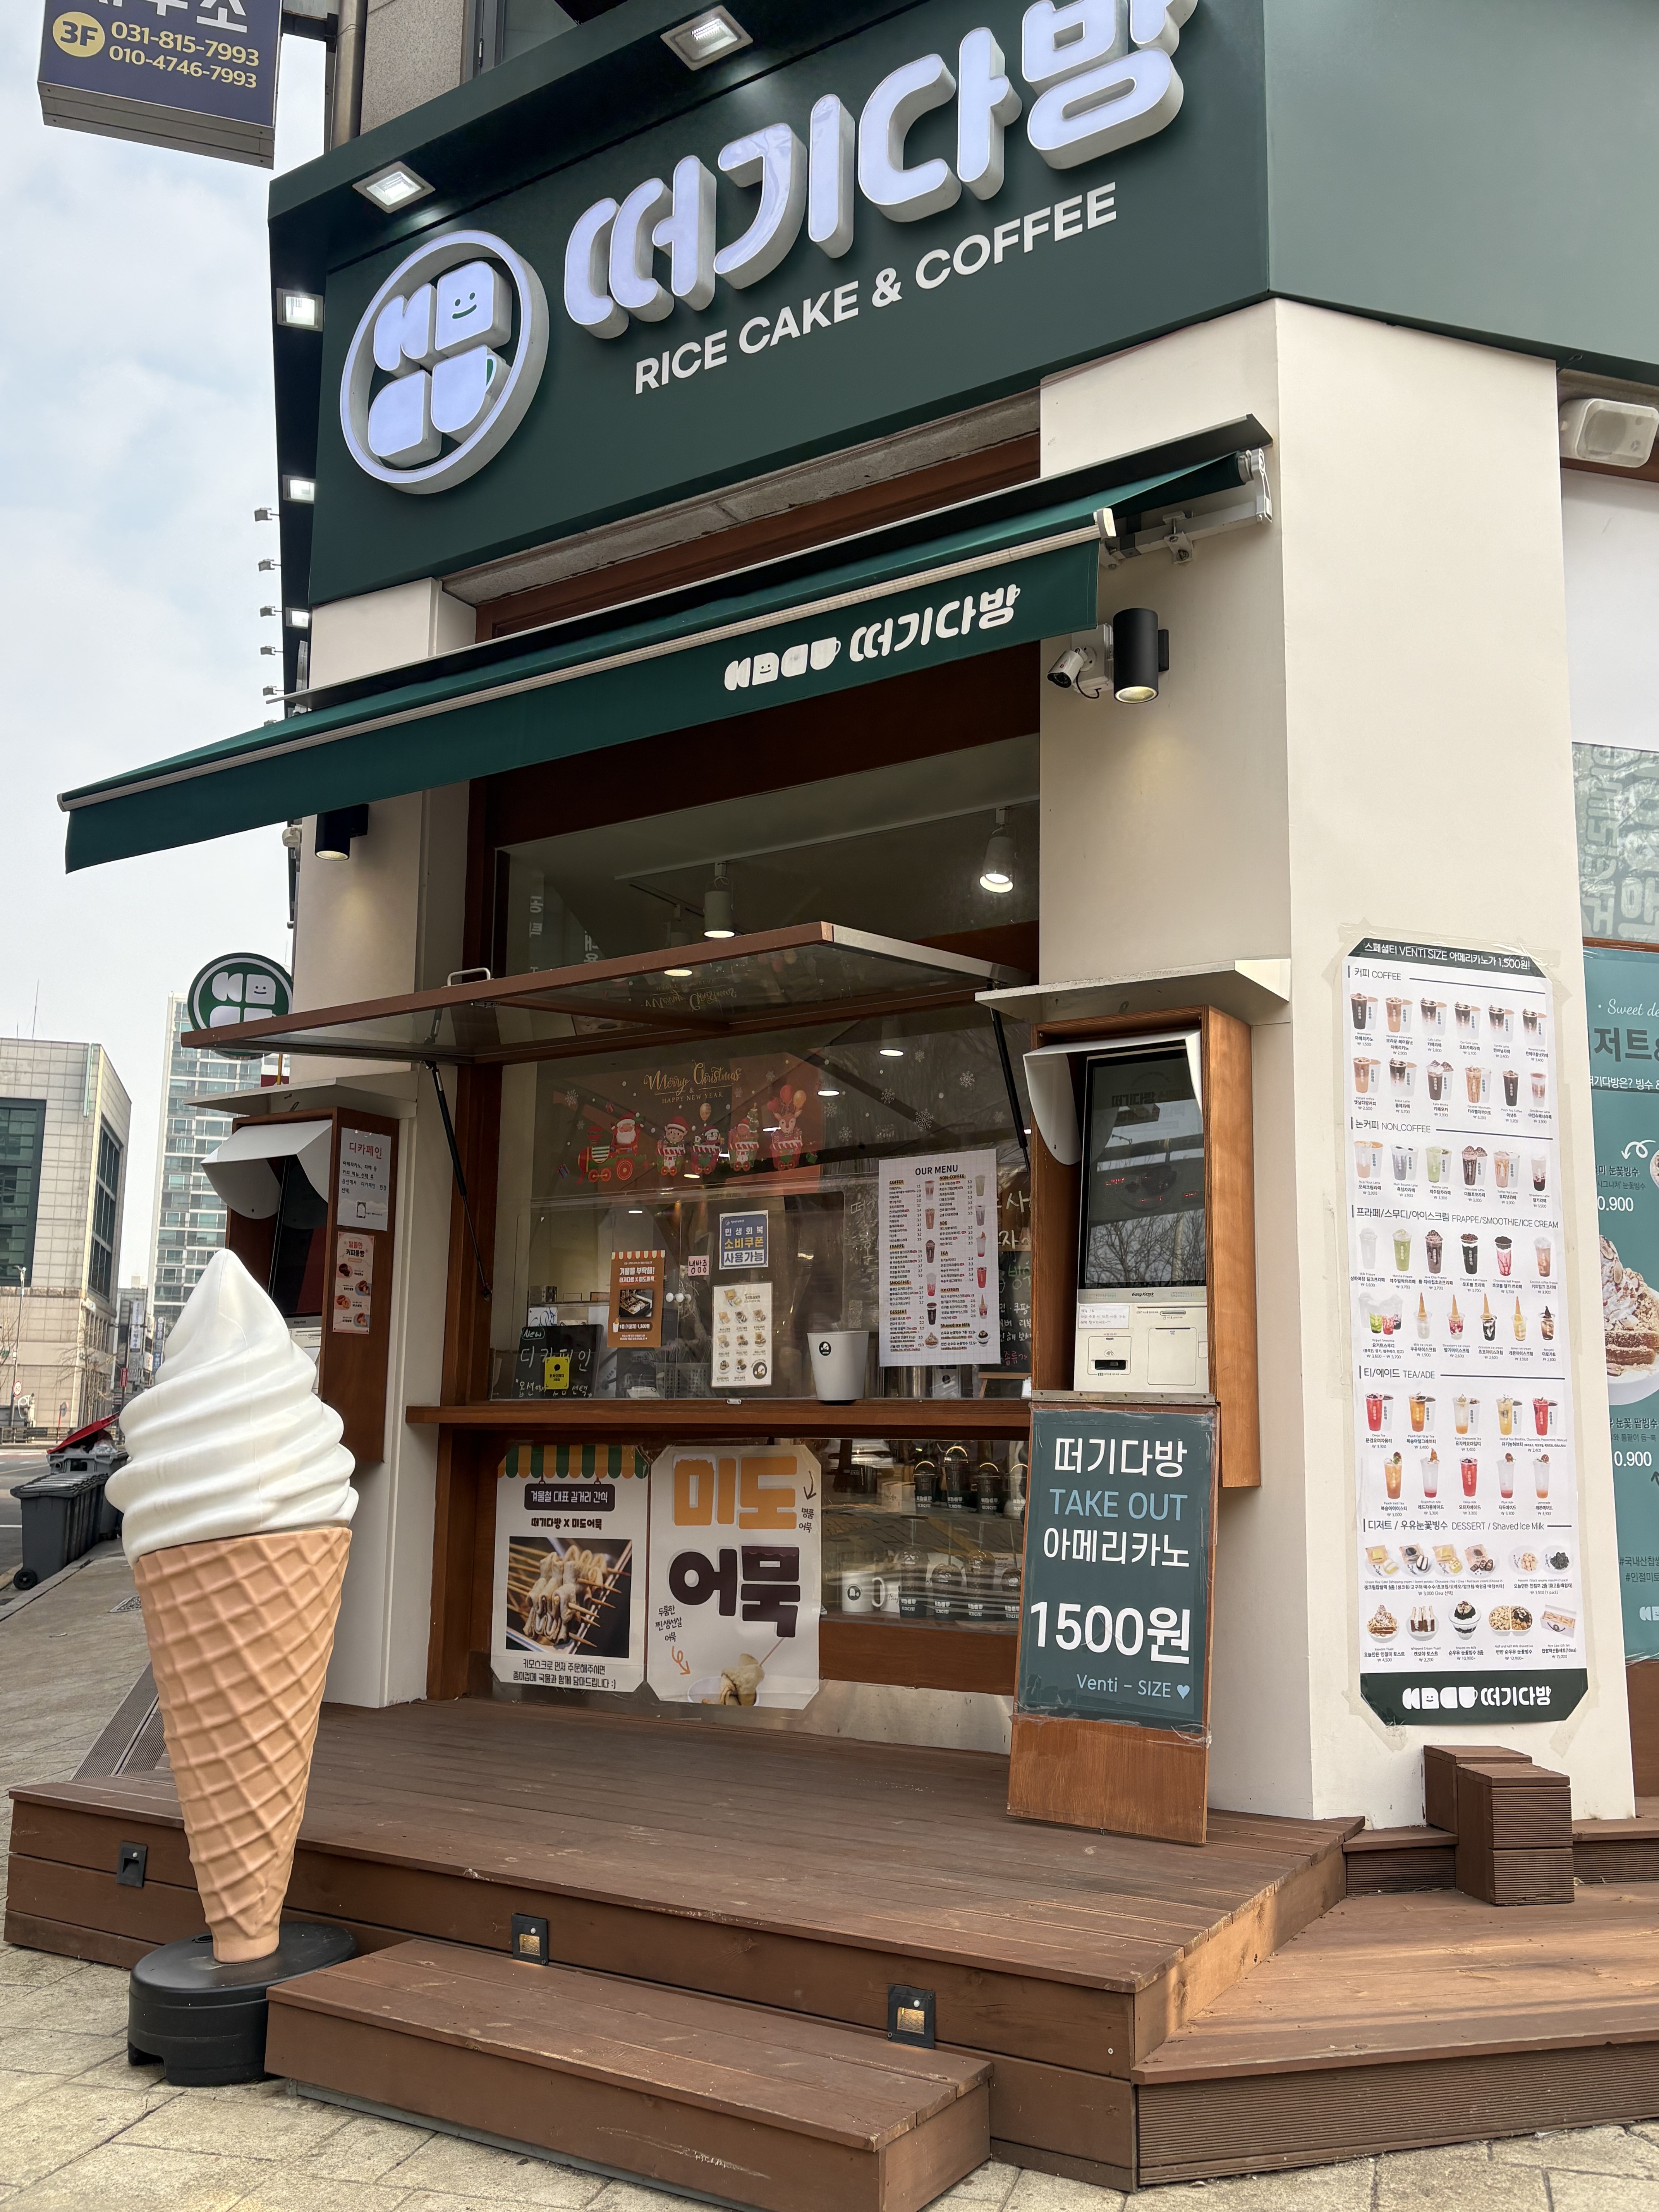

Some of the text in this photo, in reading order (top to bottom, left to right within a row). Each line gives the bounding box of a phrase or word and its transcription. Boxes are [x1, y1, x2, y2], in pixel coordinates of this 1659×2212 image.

[60, 22, 98, 46] 3F
[111, 21, 259, 67] 031-815-7993
[109, 45, 257, 88] 010-4746-7993
[563, 0, 1197, 339] 떠기다방
[634, 183, 1118, 395] RICE CAKE & COFFEE
[849, 584, 1020, 661] 떠기다방
[1364, 942, 1530, 970] 스페셜티 VENTI SIZE 아메리카노가 1,500원!
[1354, 968, 1401, 981] 커피 COFFEE
[1607, 999, 1644, 1016] Sweet
[1589, 1027, 1659, 1062] 저트
[643, 1060, 741, 1096] Merry Christmas
[1636, 1079, 1653, 1091] 빙수
[1356, 1120, 1431, 1133] 논커피 NON_COFFEE
[349, 1142, 382, 1159] 디카페인
[915, 1164, 958, 1175] OUR MENU
[1609, 1166, 1639, 1177] 눈꽃빙수
[1357, 1207, 1559, 1228] 프라페/스무디/아이스크림 FRAPPE/SMOOTHIE/ICE CREAM
[725, 1237, 764, 1249] 소비쿠폰
[725, 1251, 763, 1263] 사용가능
[689, 1259, 707, 1274] 냉방중
[524, 1328, 542, 1338] New
[1004, 1350, 1027, 1366] 종류가
[1364, 1368, 1435, 1379] 티/에이드 TEA/ADE
[1616, 1418, 1659, 1429] 눈꽃 팥빙수
[1055, 1438, 1187, 1477] 떠기다방
[531, 1491, 608, 1503] 겨울철 대표 길거리 간식
[673, 1454, 798, 1530] 미도
[1049, 1489, 1188, 1521] TAKE OUT
[801, 1507, 814, 1520] 명품
[531, 1518, 602, 1530] 떠기다방 X 미도어묵
[799, 1522, 812, 1533] 어묵
[1368, 1520, 1392, 1530] 디저트
[1400, 1520, 1448, 1530] 우유눈꽃빙수
[1492, 1522, 1519, 1530] Shaved
[1531, 1522, 1544, 1530] Milk
[1044, 1528, 1190, 1567] 아메리카노
[668, 1545, 801, 1638] 어묵
[658, 1605, 675, 1616] 두툼한
[665, 1632, 676, 1642] 어묵
[1031, 1601, 1190, 1664] 1500원
[555, 1661, 566, 1671] 먼저
[568, 1662, 605, 1675] 주문해주시면
[539, 1673, 556, 1683] 국물과
[559, 1675, 571, 1685] 함께
[1077, 1674, 1118, 1693] Venti
[1138, 1680, 1171, 1698] SIZE
[1481, 1686, 1552, 1706] 떠기다방
